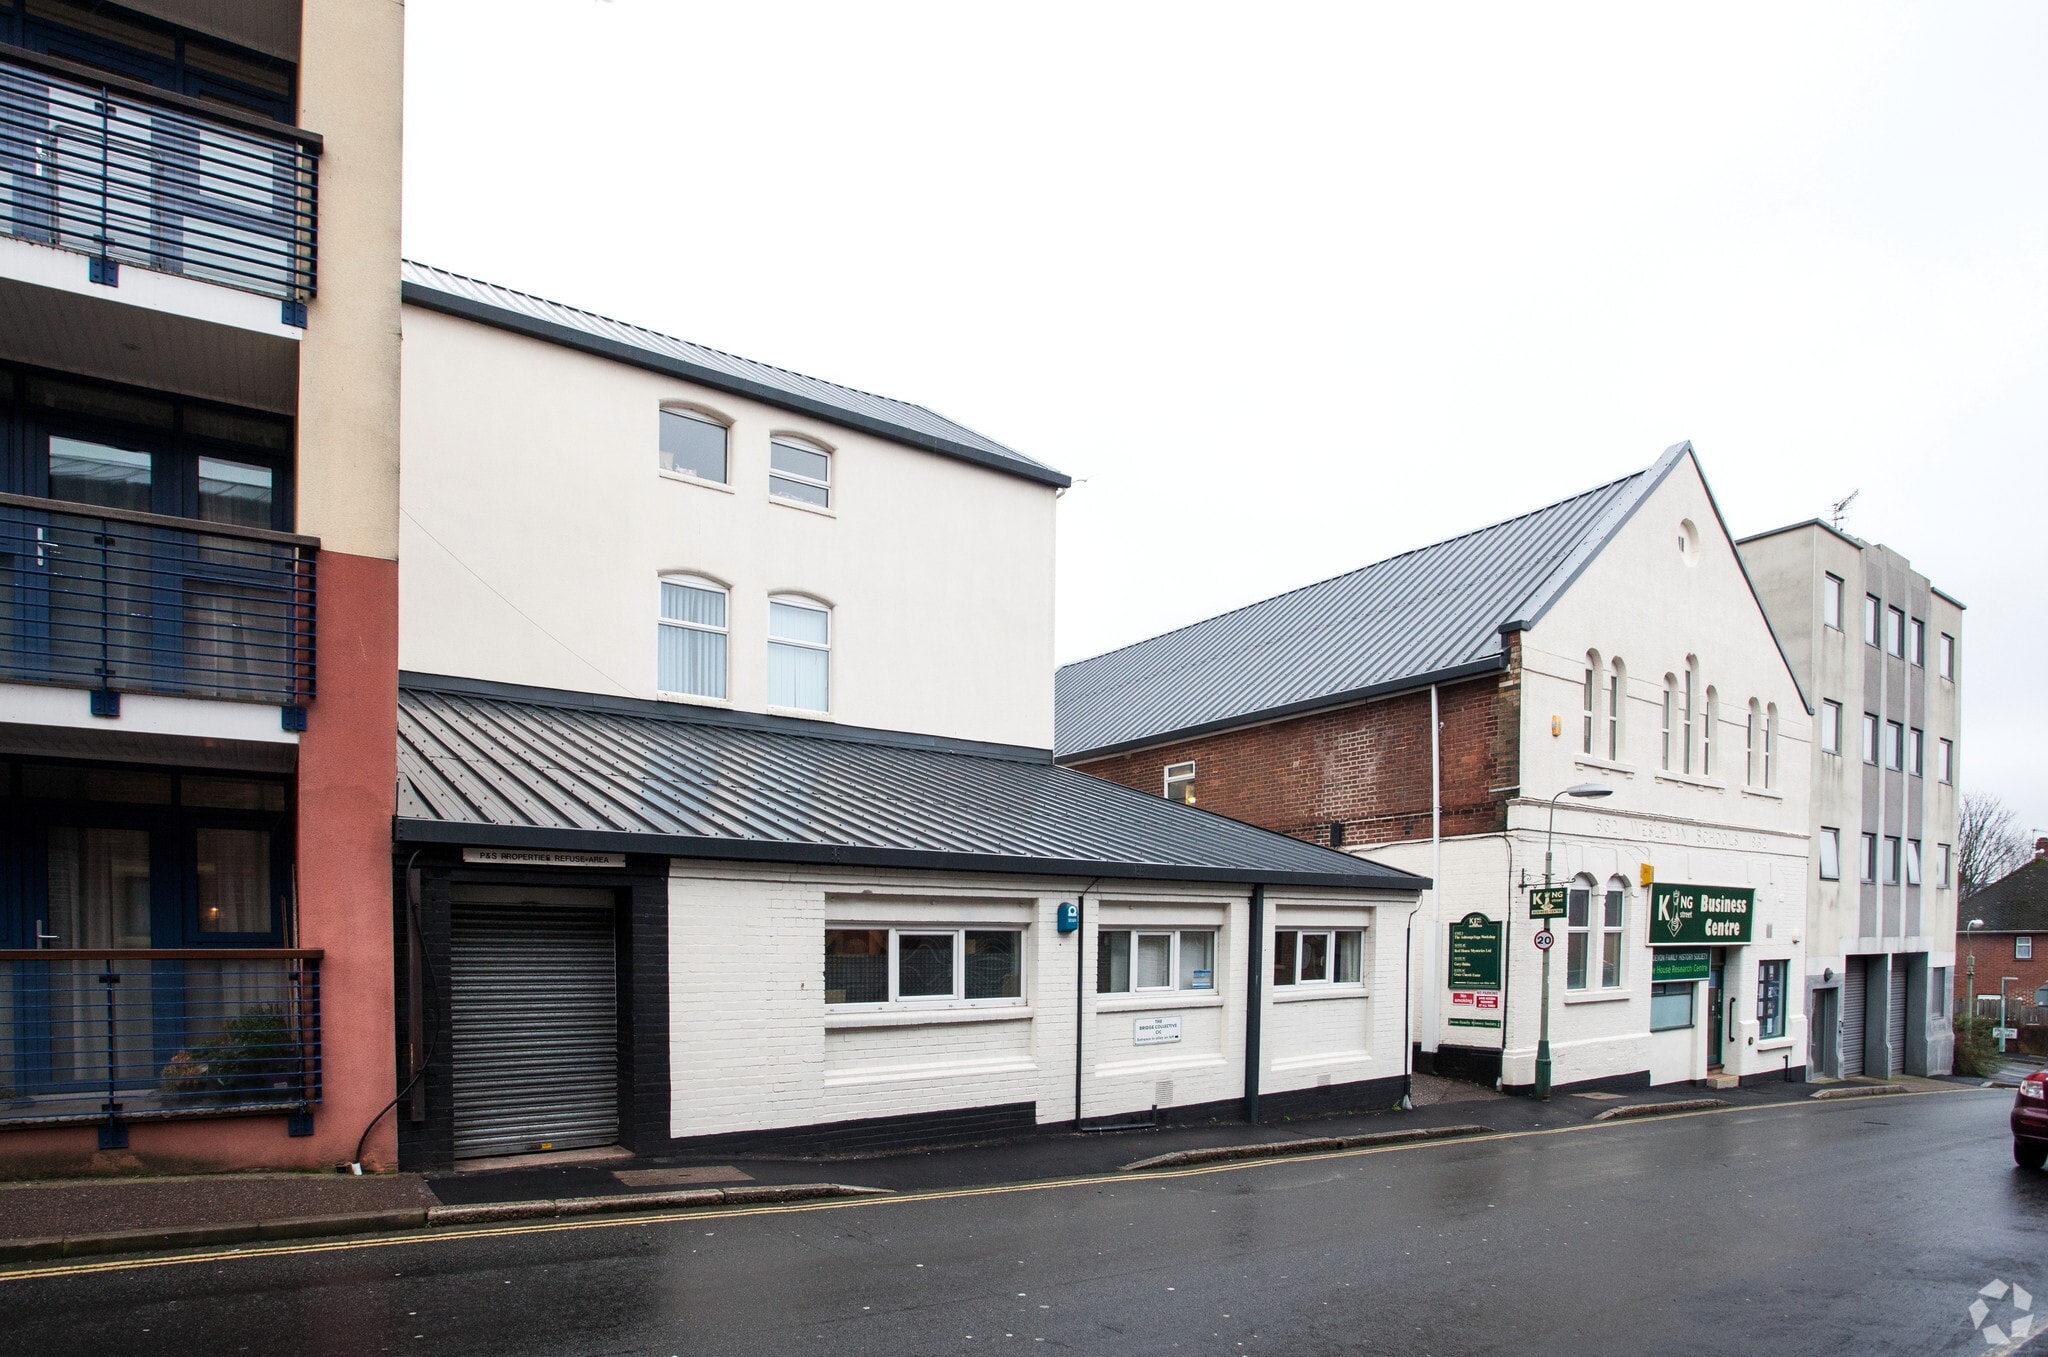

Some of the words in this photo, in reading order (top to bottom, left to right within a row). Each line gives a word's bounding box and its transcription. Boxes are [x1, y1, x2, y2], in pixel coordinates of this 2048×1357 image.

[1630, 820, 1688, 840] WESLEYAN
[1696, 828, 1739, 847] SCHOOLS
[480, 852, 498, 860] P&S
[501, 853, 550, 862] PROPERTIES
[1700, 894, 1747, 914] Business
[1705, 918, 1740, 936] Centre
[1537, 936, 1552, 944] 20
[1657, 966, 1671, 974] House
[1672, 965, 1692, 973] Research
